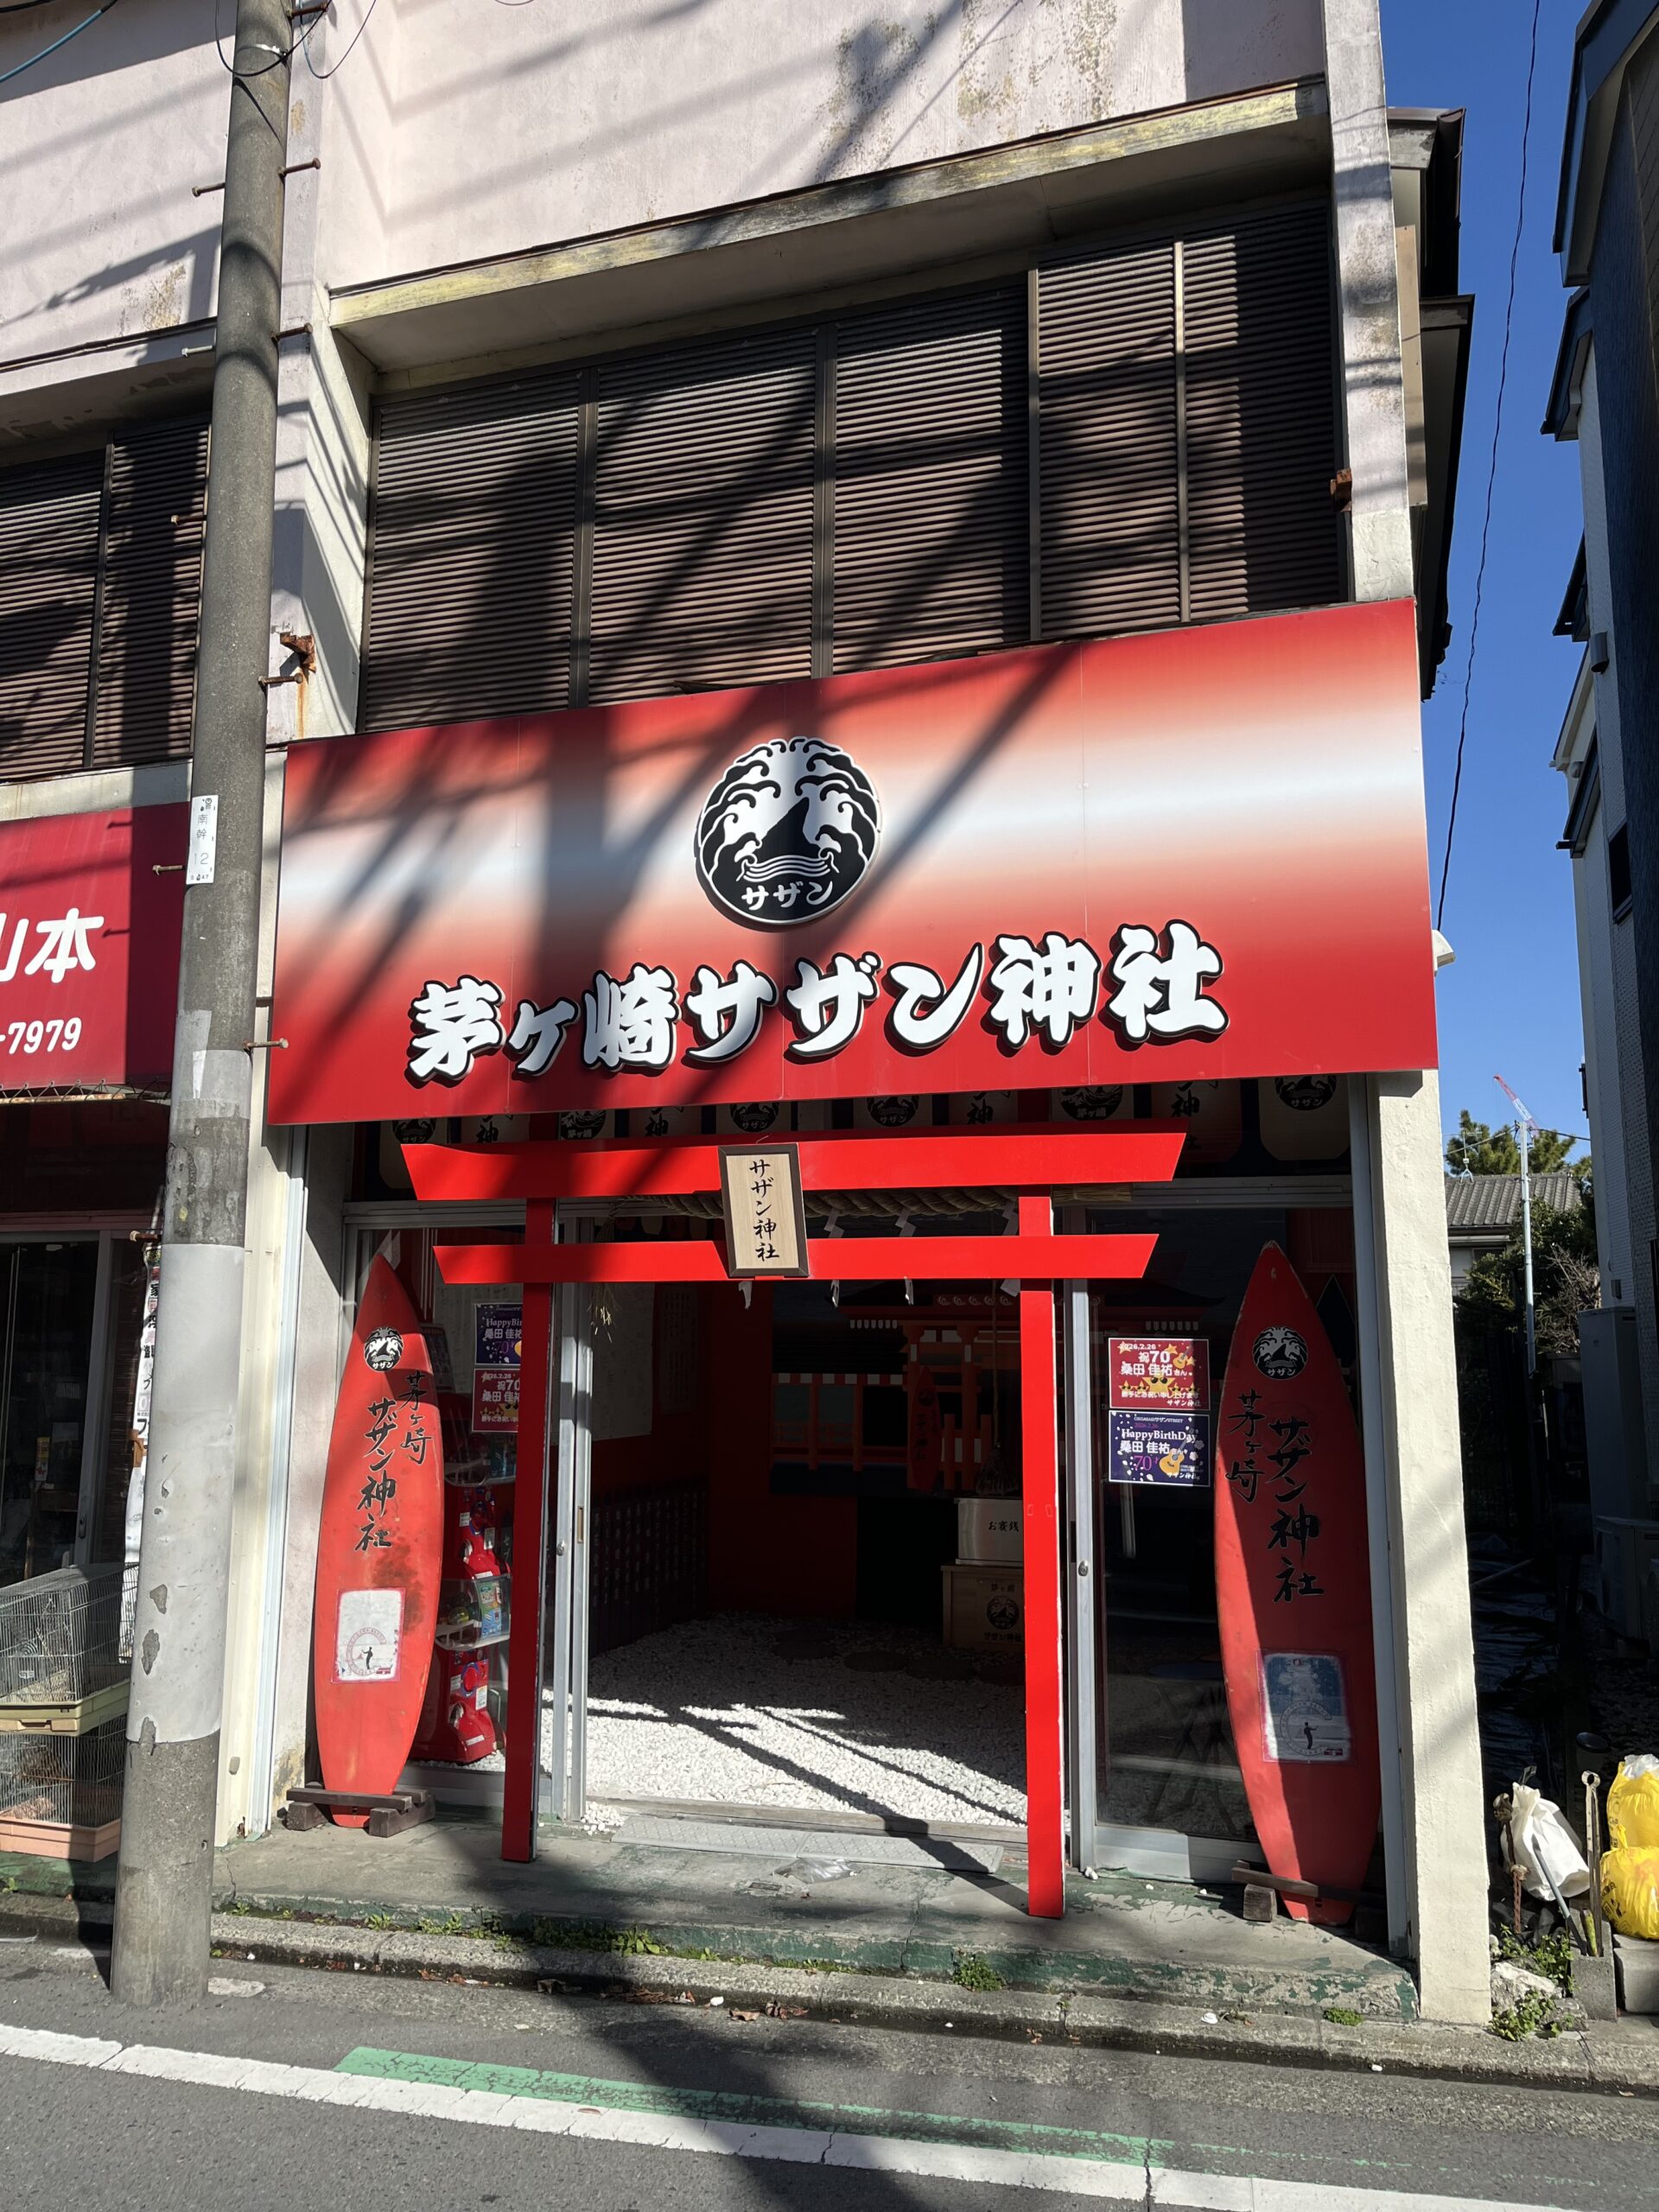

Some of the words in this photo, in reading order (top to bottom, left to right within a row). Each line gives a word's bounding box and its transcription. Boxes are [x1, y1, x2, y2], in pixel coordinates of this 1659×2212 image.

[741, 880, 833, 911] サザン
[749, 1159, 780, 1262] サザン神社
[372, 1361, 393, 1370] サザン
[1121, 1362, 1145, 1376] 桑田
[1267, 1368, 1296, 1376] サザン
[355, 1396, 397, 1552] サザン神社
[1265, 1416, 1325, 1604] サザン神社
[988, 1520, 1020, 1533] お賽銭
